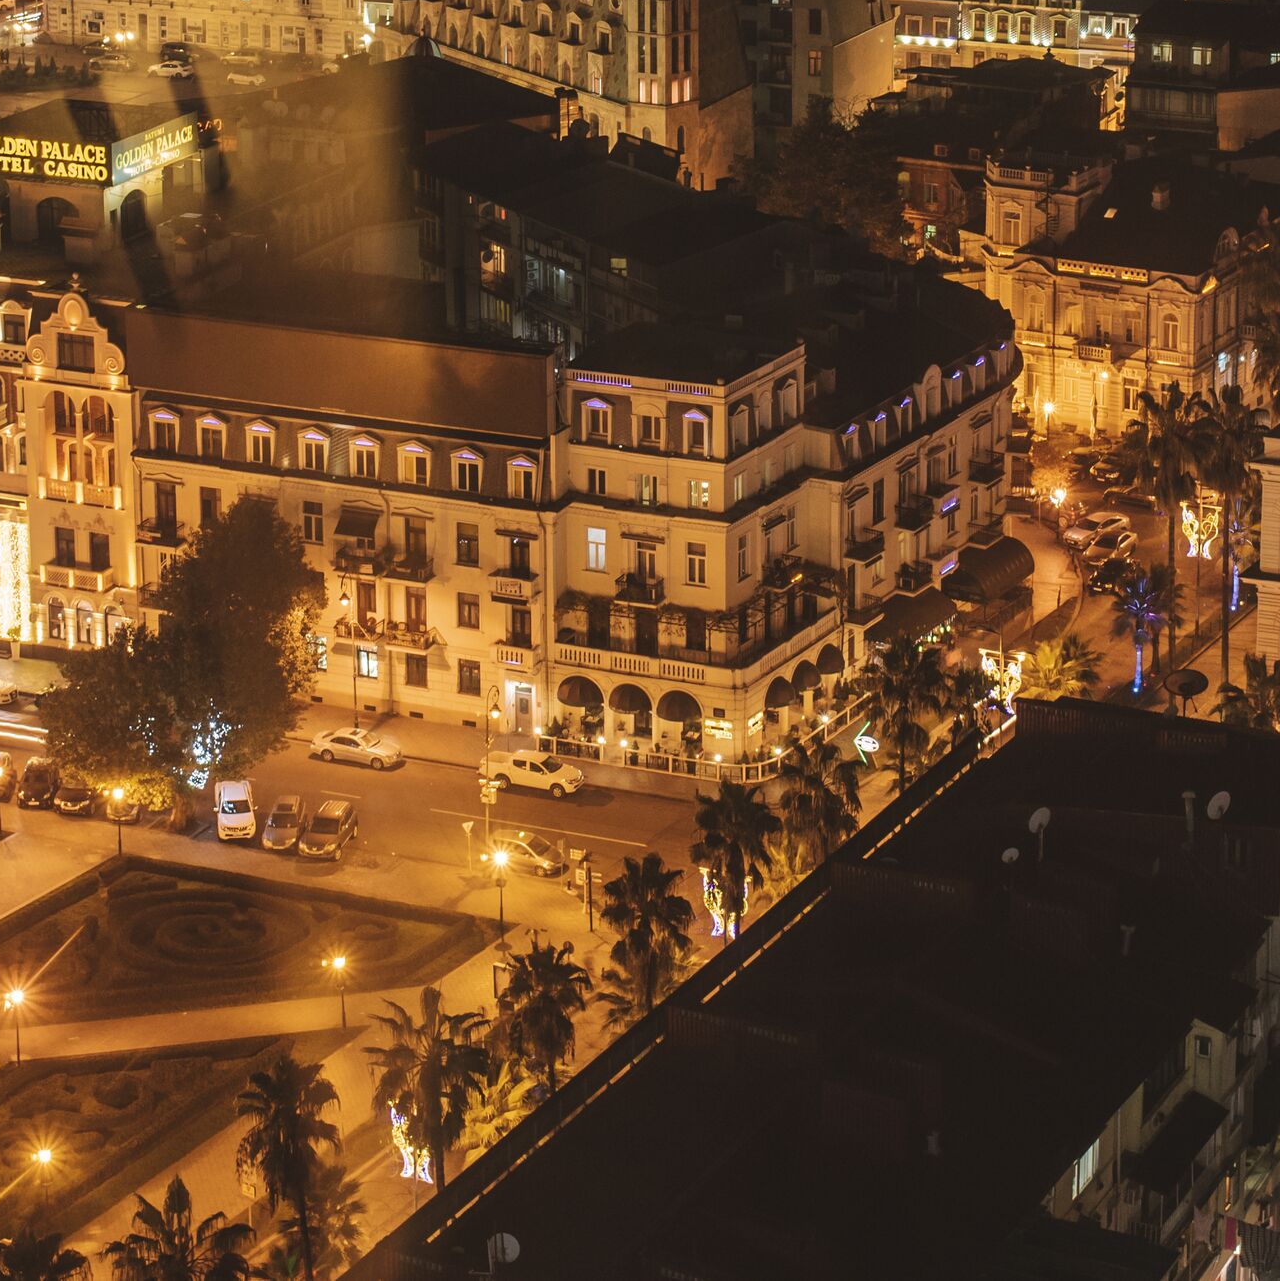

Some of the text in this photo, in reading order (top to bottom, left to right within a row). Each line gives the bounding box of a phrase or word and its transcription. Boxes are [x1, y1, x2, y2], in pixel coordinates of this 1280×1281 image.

[41, 141, 107, 165] PALACE
[115, 140, 154, 170] GOLDEN
[156, 124, 193, 154] PALACE
[43, 163, 108, 182] CASINO
